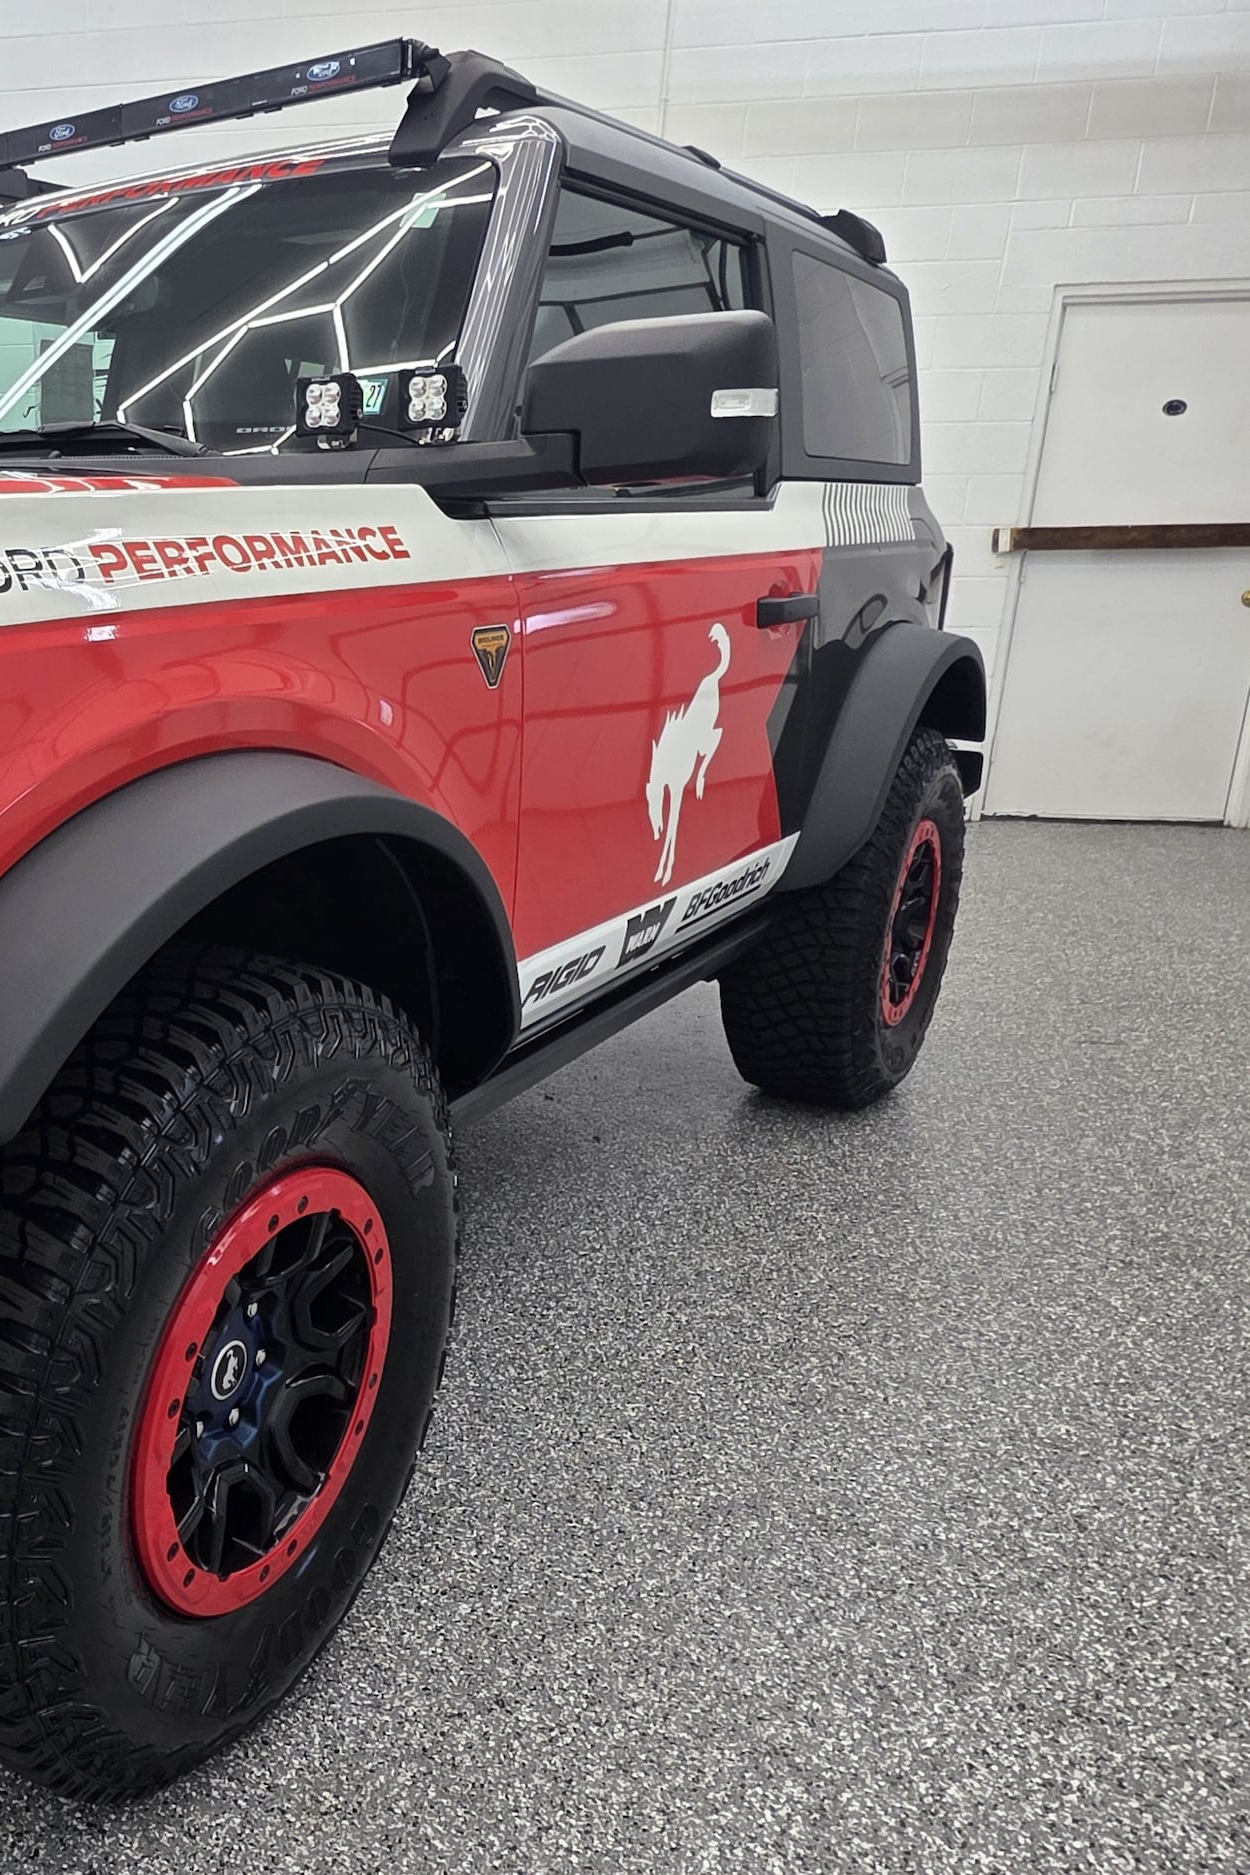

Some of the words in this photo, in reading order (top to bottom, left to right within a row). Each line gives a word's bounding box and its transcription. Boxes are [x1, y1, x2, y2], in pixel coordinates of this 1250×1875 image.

[291, 85, 308, 96] FORD
[156, 116, 171, 126] FORD
[37, 159, 326, 219] PERFORMANCE
[365, 384, 382, 409] 27
[87, 525, 411, 584] PERFORMANCE
[681, 857, 770, 923] BFGoodrich
[625, 922, 661, 954] WARN
[521, 945, 607, 1008] RIGID
